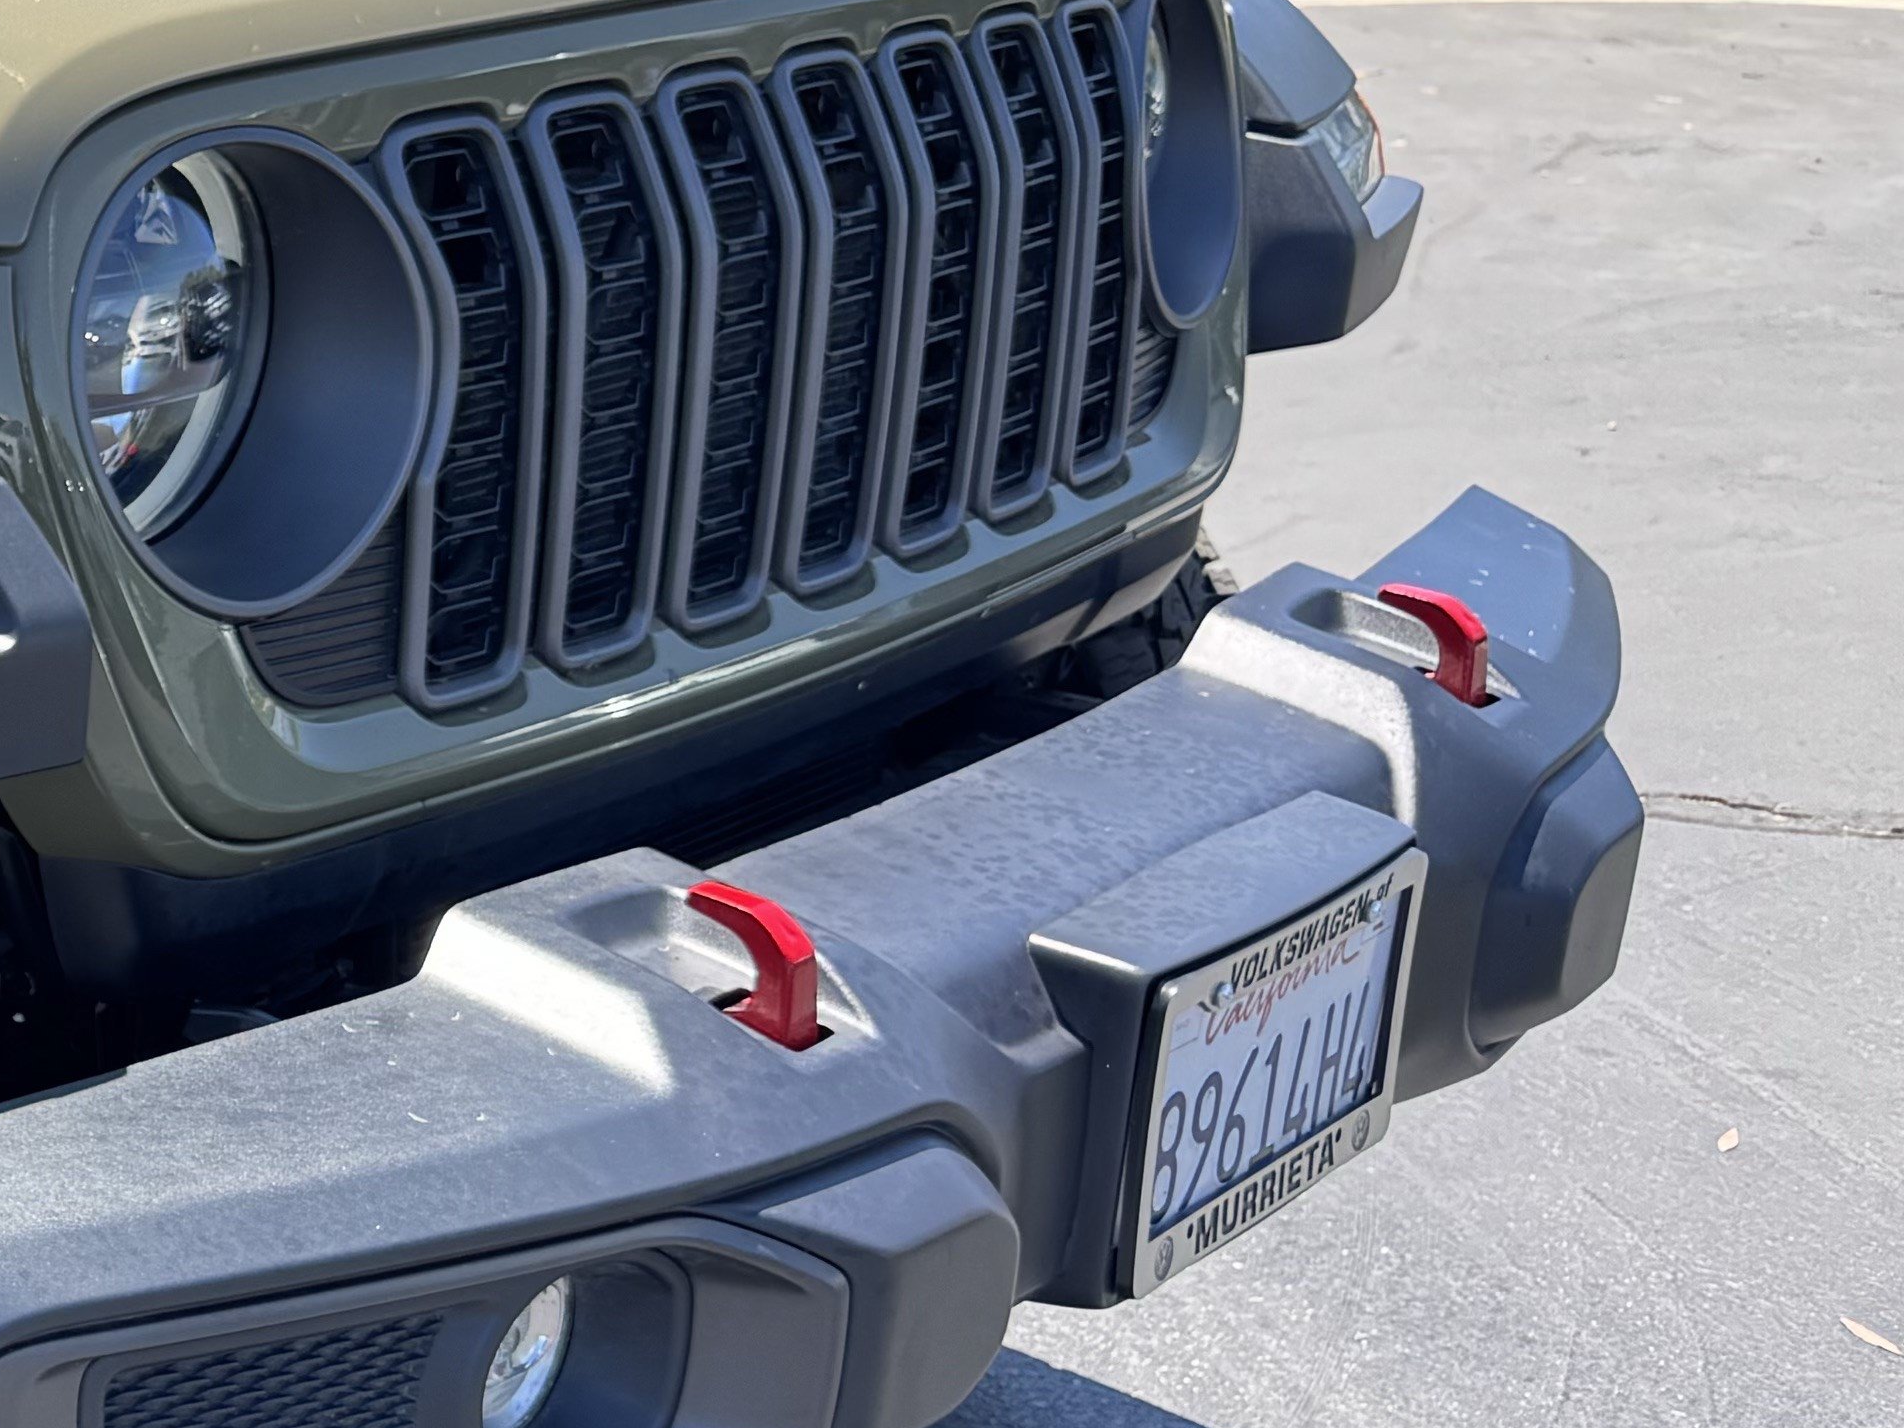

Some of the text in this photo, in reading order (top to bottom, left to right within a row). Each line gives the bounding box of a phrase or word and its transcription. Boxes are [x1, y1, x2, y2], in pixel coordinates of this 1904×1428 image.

[1231, 889, 1371, 994] VOLKSWAGEN
[1150, 980, 1370, 1225] 89614H4
[1194, 1132, 1336, 1255] MURRIETA
